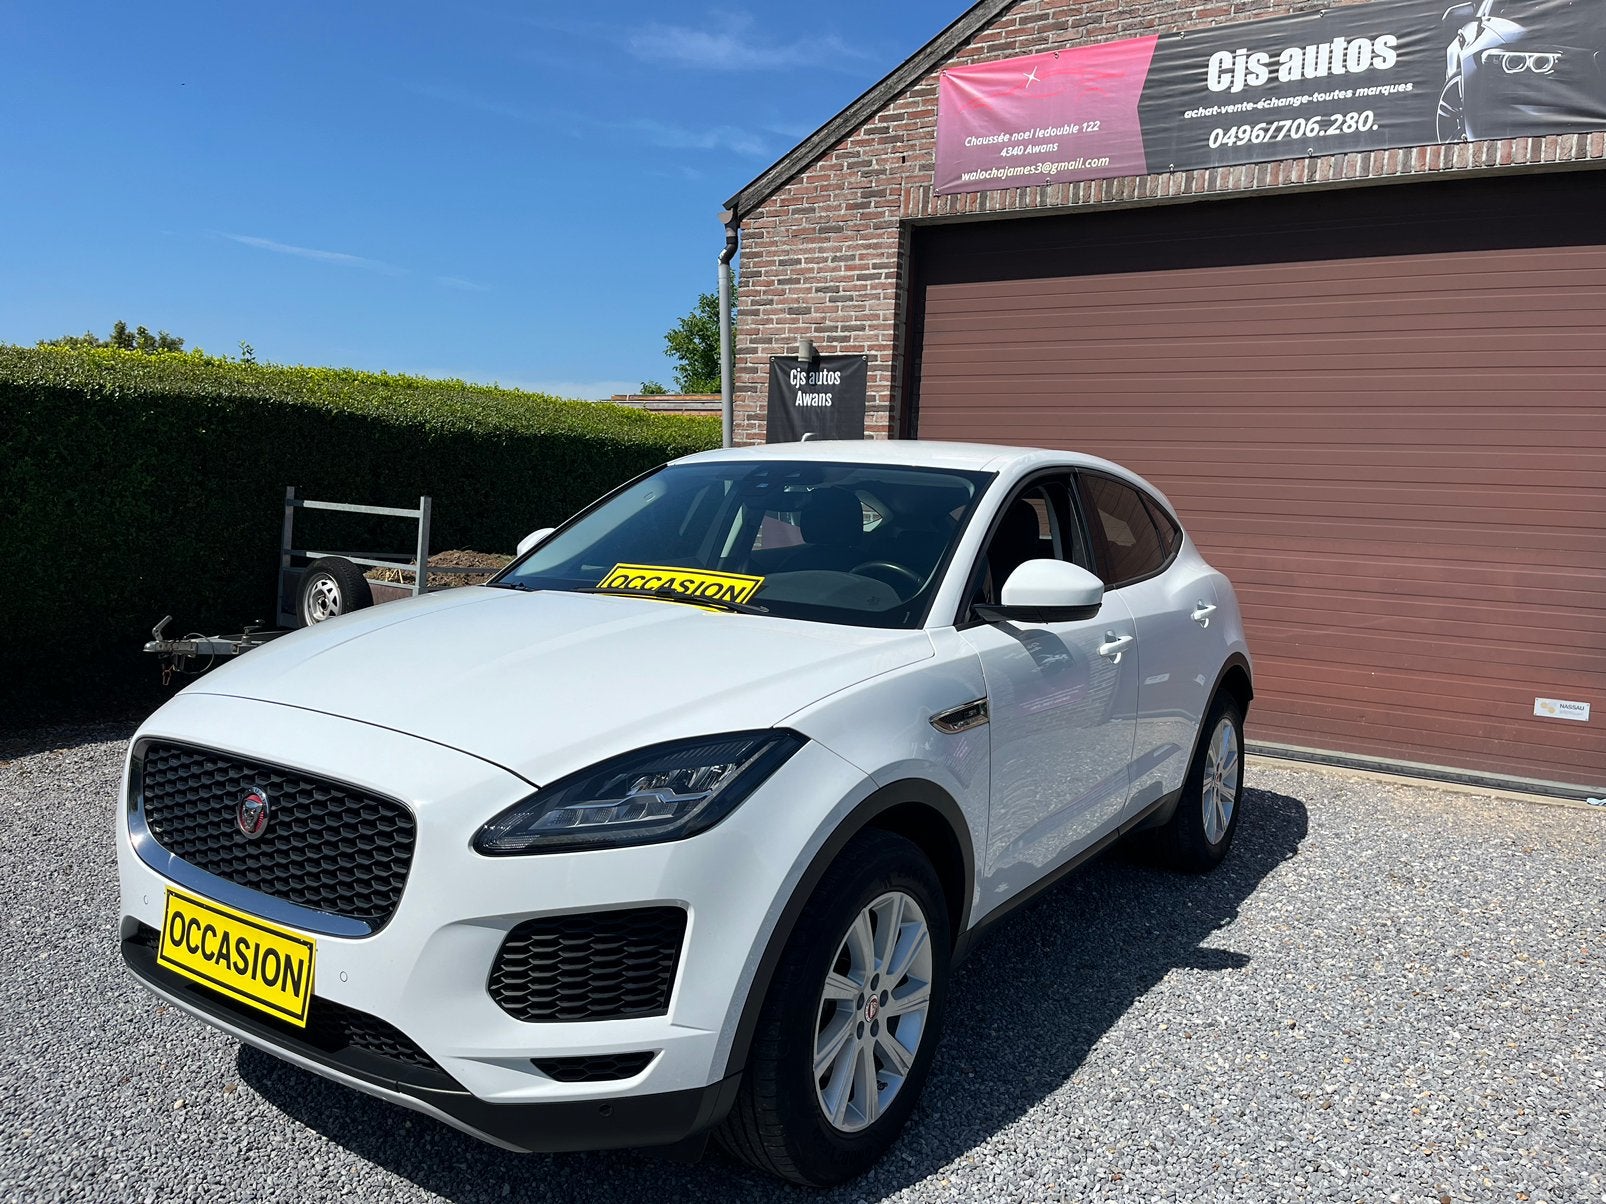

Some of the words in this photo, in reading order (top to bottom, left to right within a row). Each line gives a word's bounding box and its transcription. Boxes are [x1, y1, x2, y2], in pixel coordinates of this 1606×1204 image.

[1208, 48, 1269, 93] Cjs
[1278, 34, 1397, 82] autos
[1184, 89, 1353, 119] achat-vente-échange-toutes
[1355, 82, 1413, 97] marques
[965, 132, 1009, 147] Chaussée
[1012, 129, 1033, 141] noel
[1035, 123, 1079, 138] ledouble
[1082, 120, 1100, 132] 122
[1208, 111, 1378, 148] 0496/706.280.
[1000, 146, 1024, 157] 4340
[1025, 142, 1058, 154] Awans
[961, 156, 1109, 181] walochajames3@gmail.com
[790, 368, 806, 388] Cjs
[809, 369, 840, 385] autos
[795, 391, 832, 406] Awans
[607, 574, 747, 603] OCCASION
[170, 911, 304, 998] OCCASION
